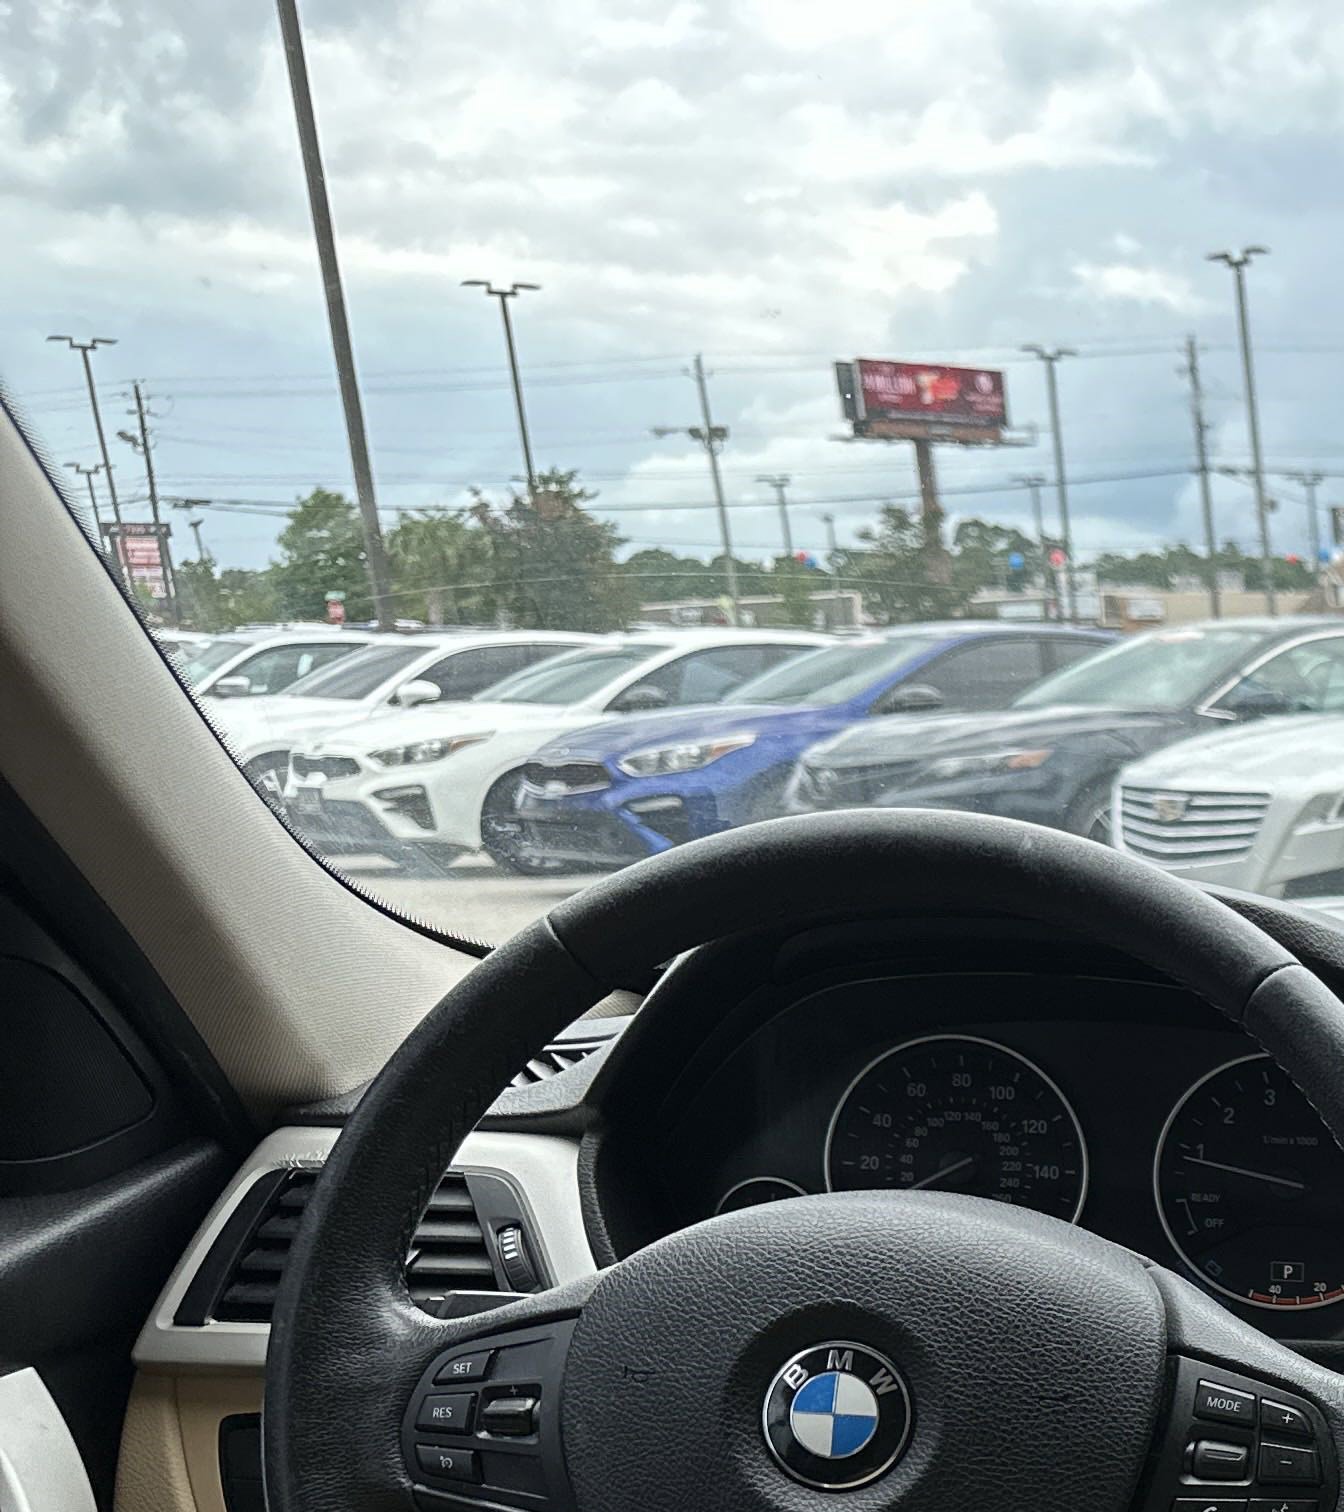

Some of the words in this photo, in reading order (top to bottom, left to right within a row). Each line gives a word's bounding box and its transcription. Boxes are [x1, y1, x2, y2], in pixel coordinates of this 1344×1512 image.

[952, 1073, 971, 1087] 80
[907, 1083, 926, 1098] 60
[989, 1086, 1015, 1100] 100
[1264, 1089, 1276, 1106] 3
[872, 1113, 892, 1128] 40
[1223, 1108, 1235, 1124] 2
[1021, 1119, 1047, 1134] 120
[860, 1156, 879, 1170] 20
[1032, 1165, 1059, 1179] 140
[1191, 1193, 1220, 1202] READY
[1204, 1218, 1224, 1228] OFF
[1283, 1265, 1293, 1279] P
[1268, 1284, 1282, 1295] 40
[1313, 1282, 1327, 1292] 20
[453, 1361, 472, 1374] SET
[783, 1349, 898, 1396] BMW
[1206, 1396, 1242, 1413] MODE
[432, 1406, 452, 1418] RES
